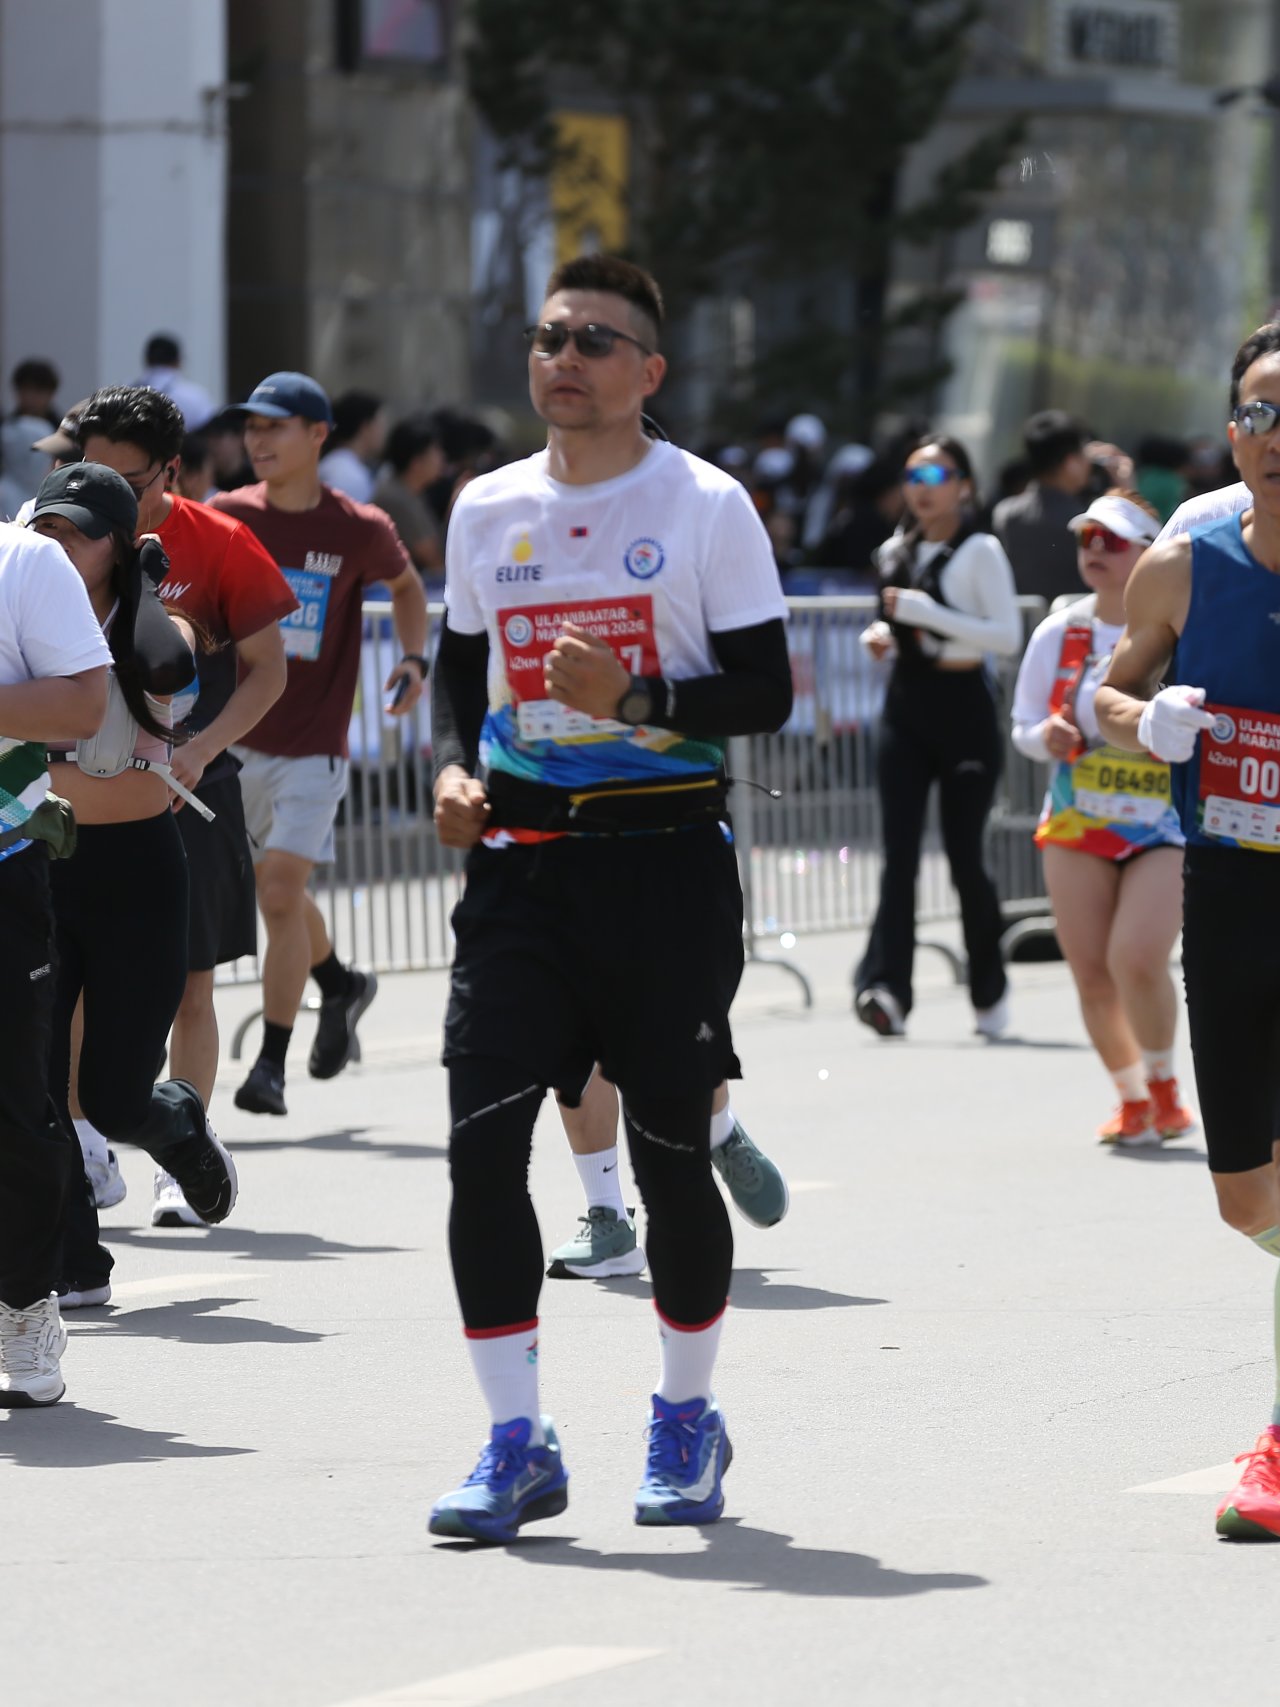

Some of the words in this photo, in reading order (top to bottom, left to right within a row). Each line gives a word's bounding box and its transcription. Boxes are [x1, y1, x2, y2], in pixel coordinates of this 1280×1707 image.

[496, 565, 542, 582] ELITE
[535, 607, 627, 626] ULAANBAATAR
[610, 620, 647, 635] 2026
